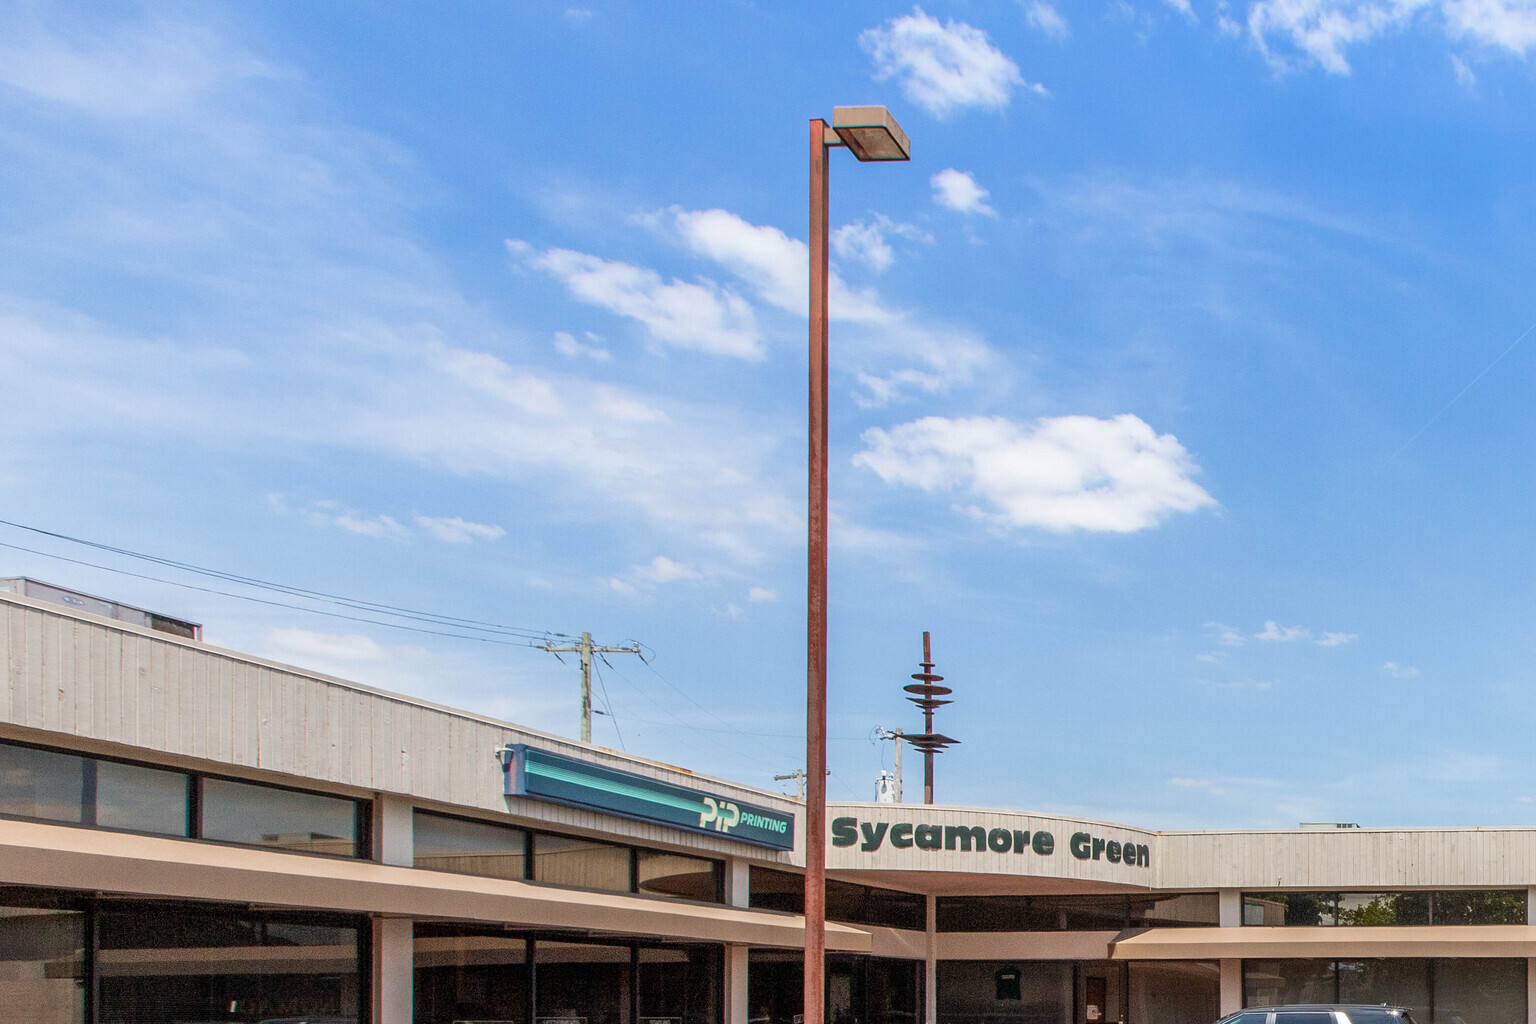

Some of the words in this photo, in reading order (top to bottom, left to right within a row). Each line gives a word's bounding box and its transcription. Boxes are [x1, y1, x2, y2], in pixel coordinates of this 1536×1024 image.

[740, 812, 787, 834] PRINTING
[831, 816, 1055, 856] Sycamore
[1069, 831, 1150, 868] Green
